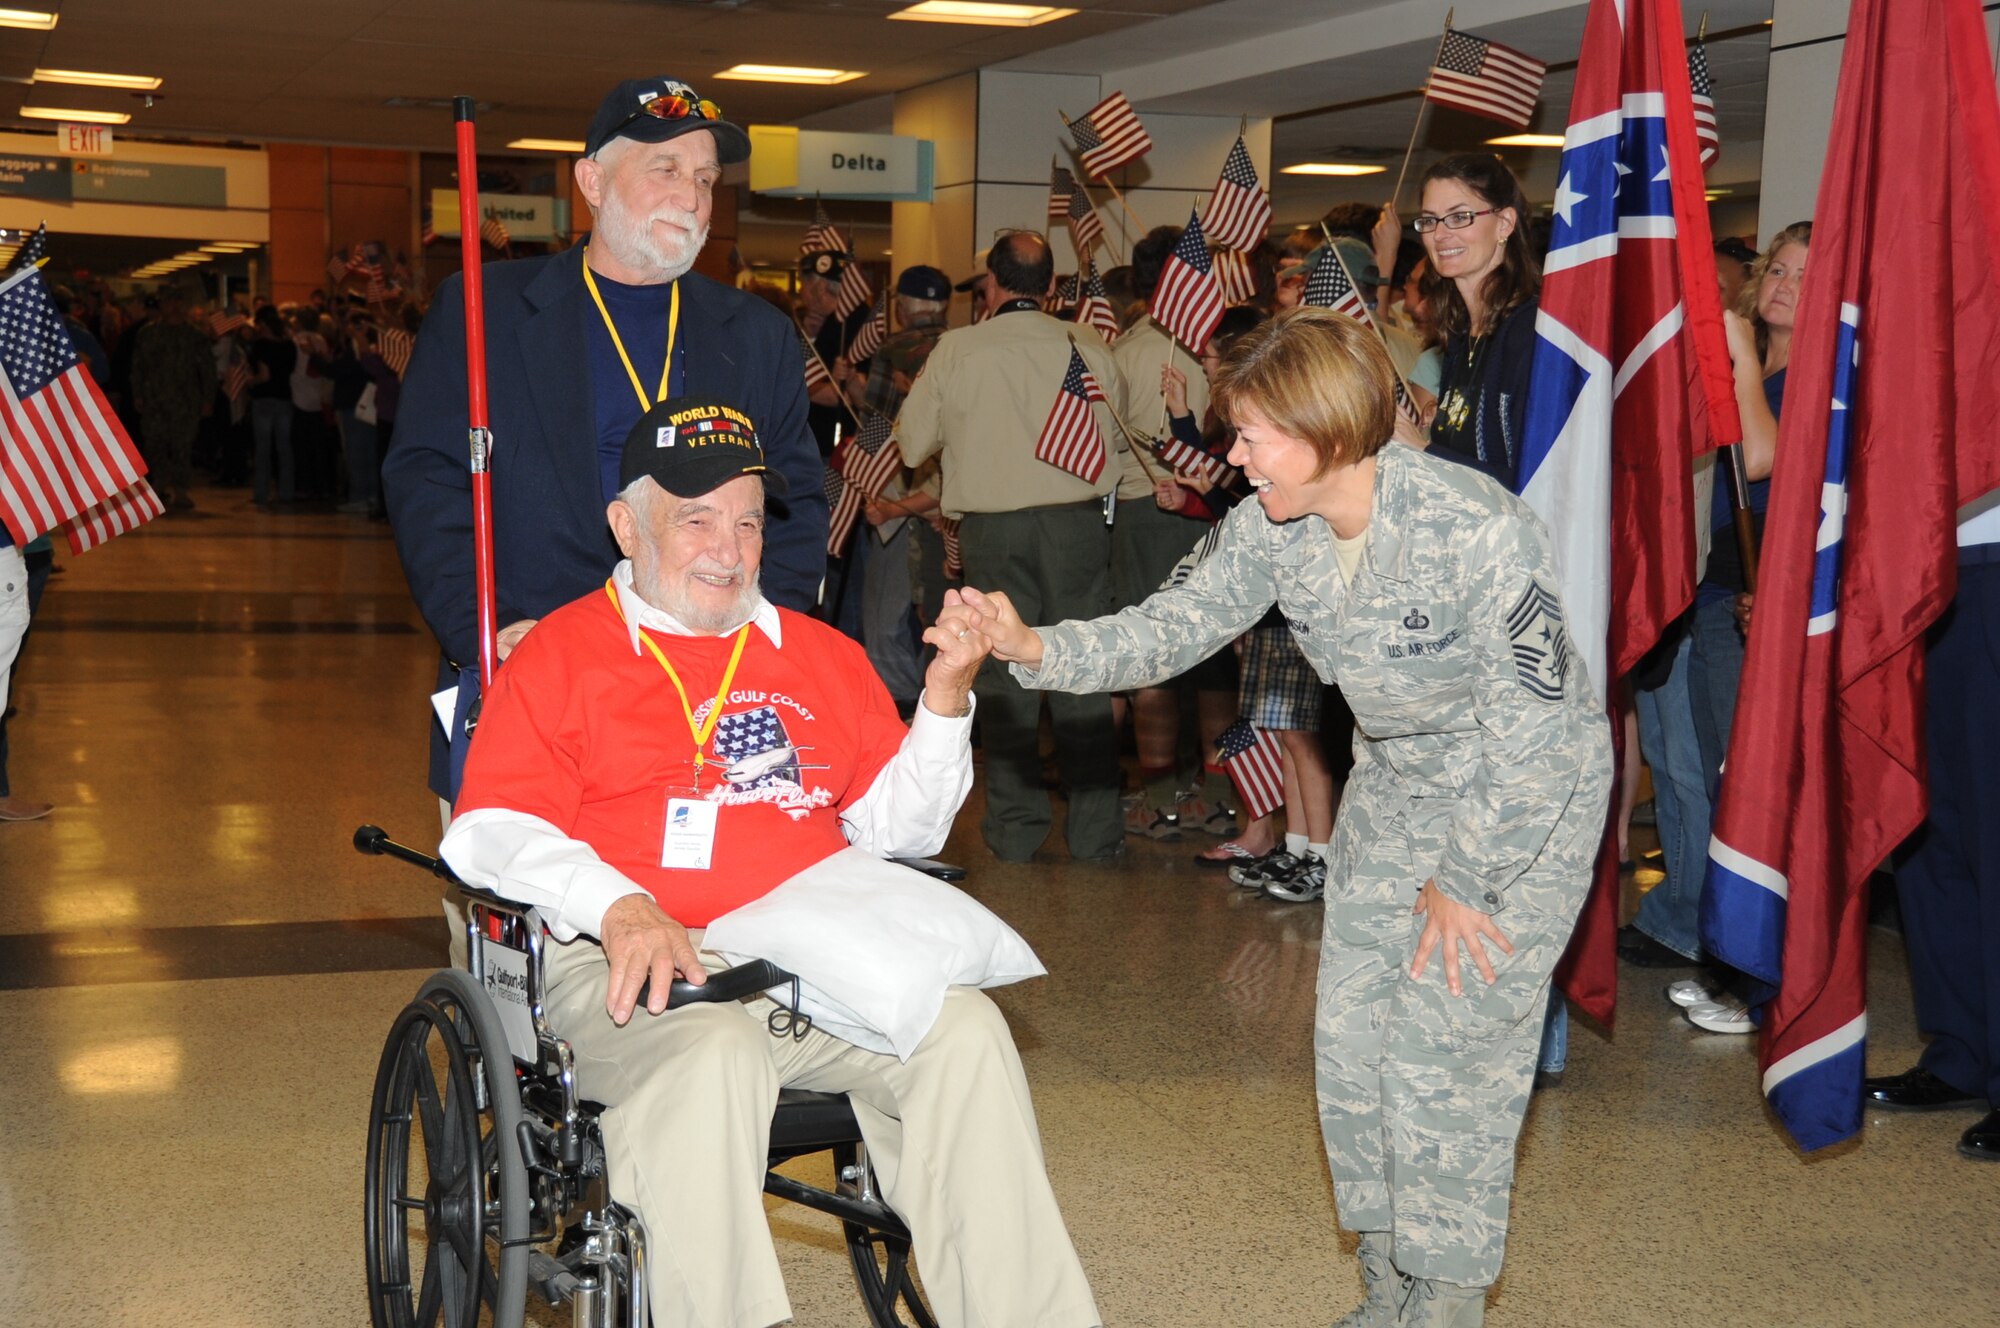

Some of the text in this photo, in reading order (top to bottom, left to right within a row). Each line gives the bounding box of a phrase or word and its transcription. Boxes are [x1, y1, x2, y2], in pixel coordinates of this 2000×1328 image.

[69, 126, 104, 153] EXIT
[0, 159, 41, 172] aggage
[831, 153, 886, 171] Delta
[0, 171, 25, 183] laim
[484, 207, 535, 221] United
[669, 405, 720, 427] WORLD
[687, 432, 752, 449] VETERAN
[1387, 628, 1461, 659] U.S. AIR FORCE
[729, 690, 767, 704] GULF
[769, 692, 816, 721] COAST
